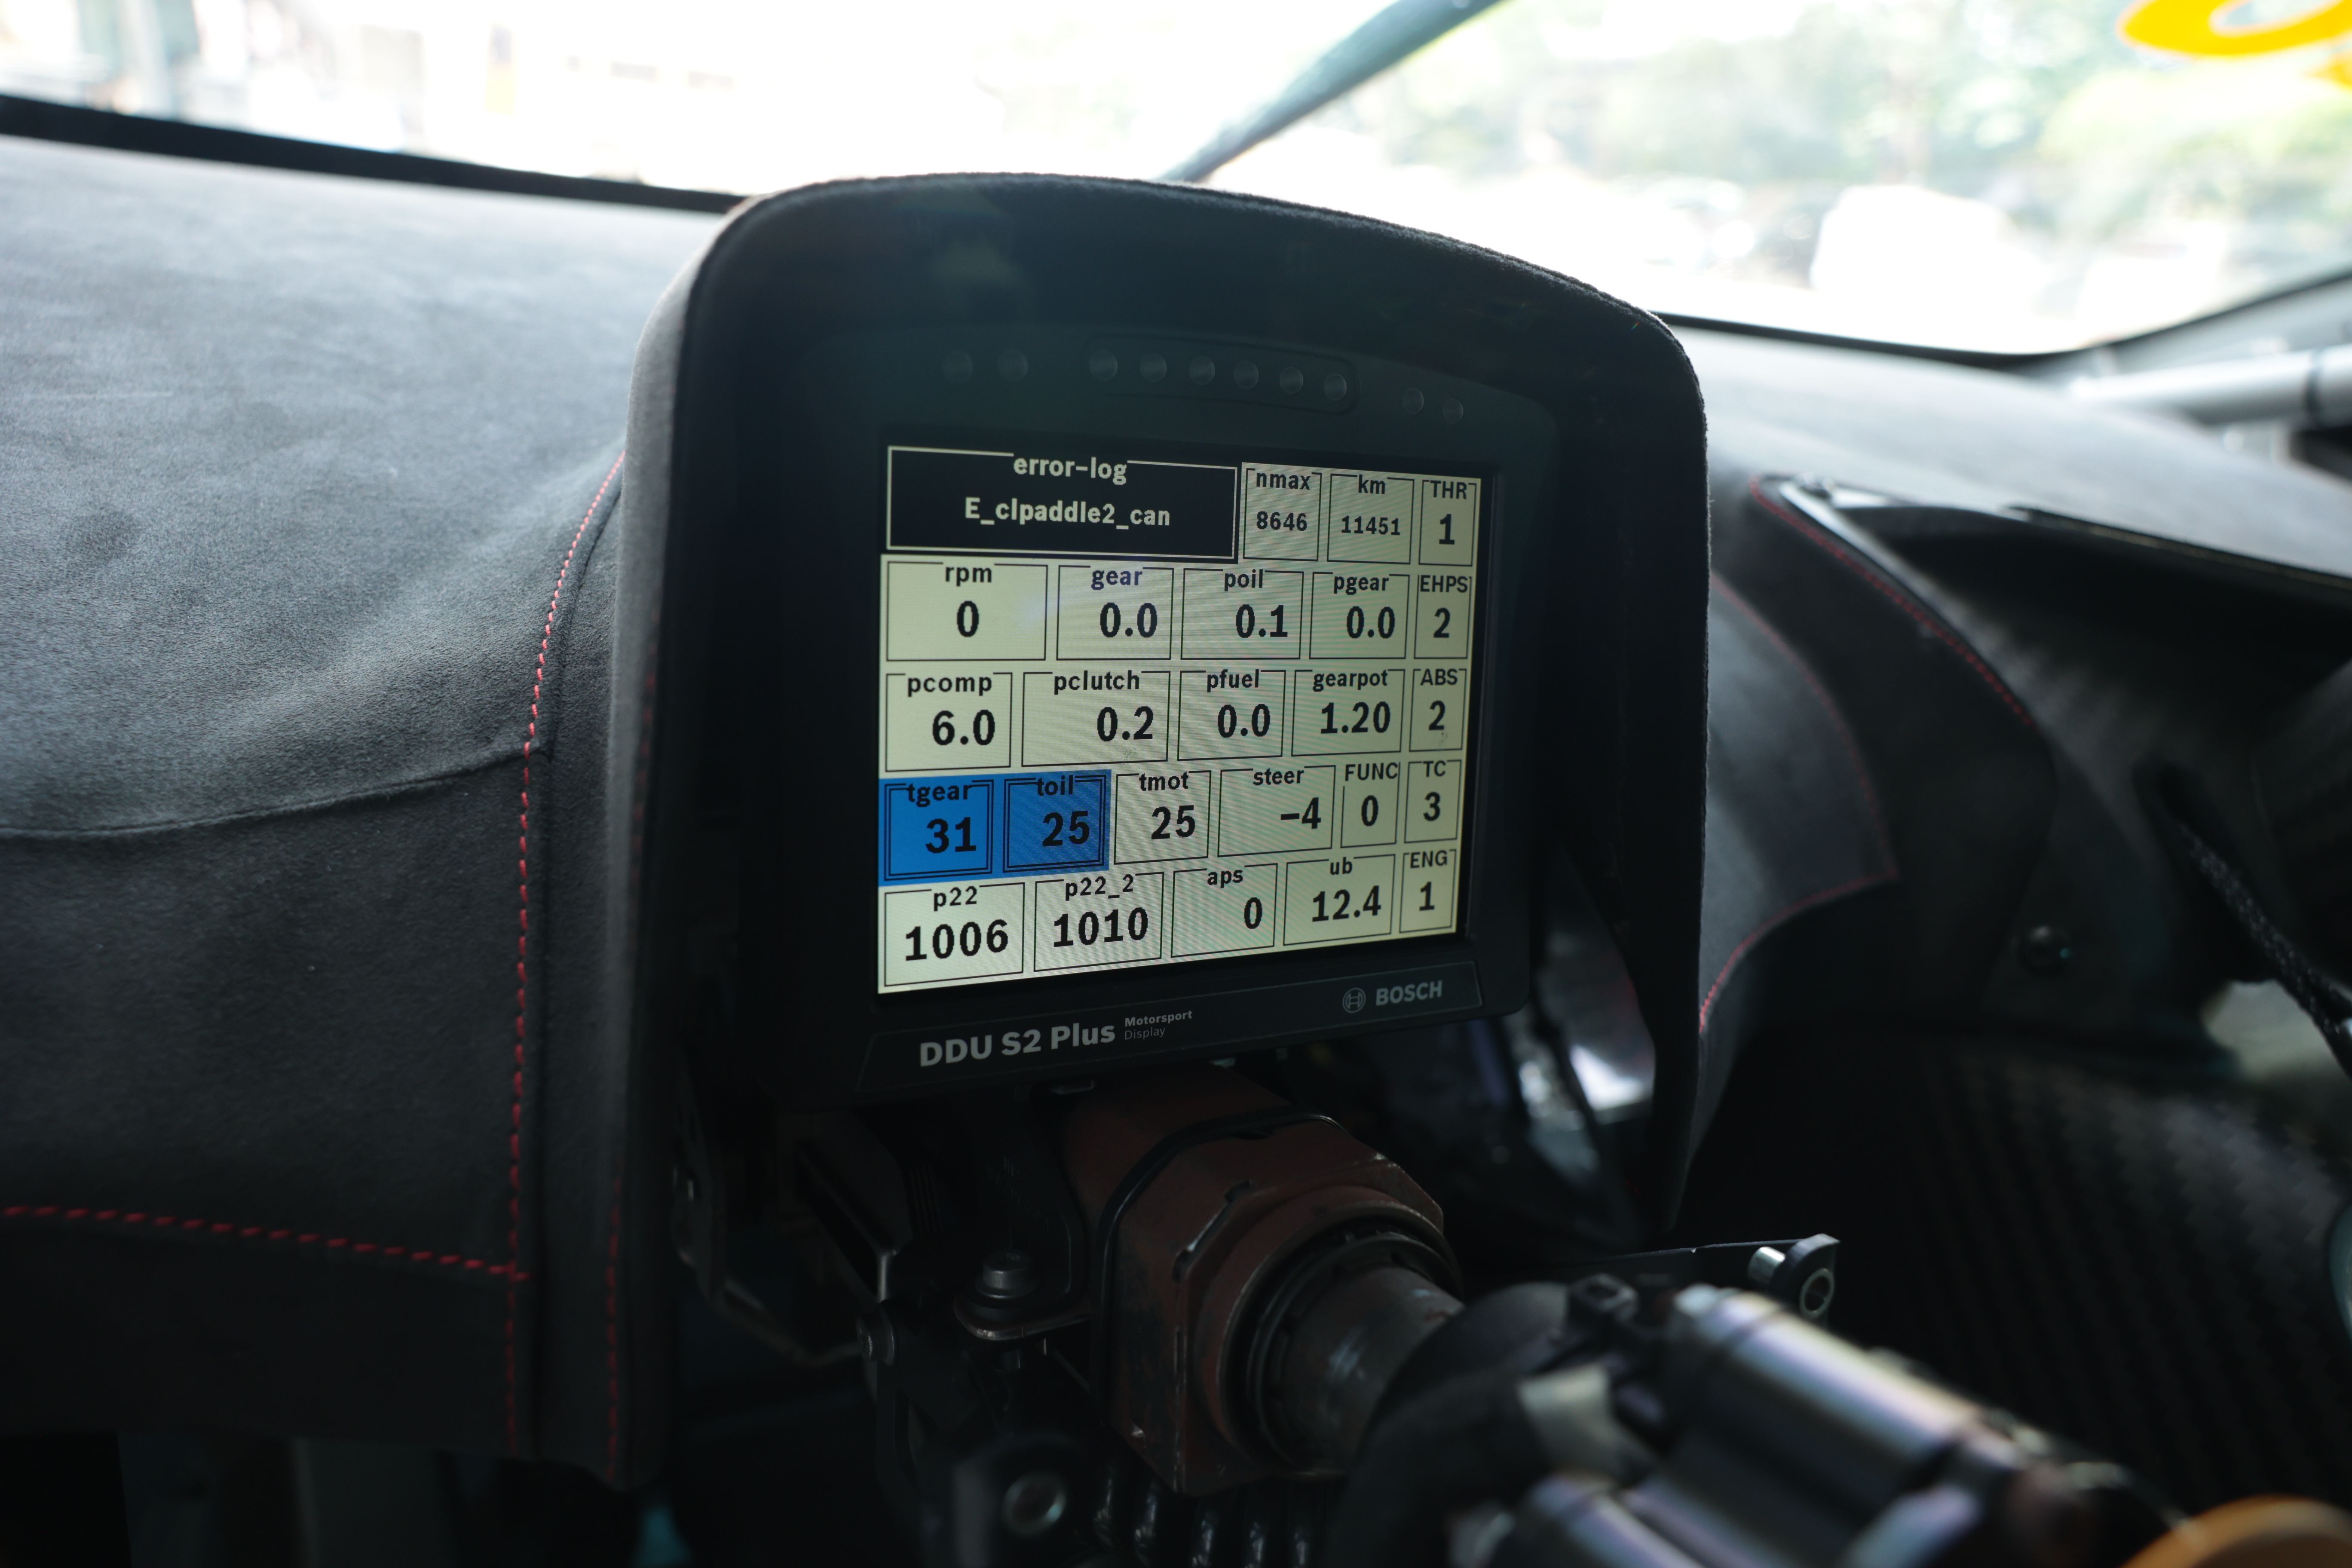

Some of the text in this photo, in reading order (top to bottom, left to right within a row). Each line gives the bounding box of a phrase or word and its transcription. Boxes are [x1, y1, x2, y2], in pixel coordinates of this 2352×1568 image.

[1014, 456, 1127, 485] error-log
[1256, 472, 1311, 490] nmax
[1358, 475, 1386, 495] km
[1430, 481, 1467, 499] THR
[965, 497, 1170, 530] E_clpaddle2_can
[1256, 511, 1308, 531] 8646
[1341, 516, 1400, 536] 11451
[1438, 514, 1455, 545] 1
[945, 566, 992, 587] rpm
[1091, 568, 1143, 591] gear
[1224, 569, 1264, 591] poil
[1333, 574, 1390, 595] pgear
[1420, 575, 1468, 593] EHPS
[956, 600, 980, 638] 0
[1099, 602, 1158, 638] 0.0
[1235, 604, 1288, 638] 0.1
[1346, 606, 1396, 639] 0.0
[1433, 607, 1451, 638] 2
[907, 675, 992, 697] pcomp
[1054, 671, 1140, 695] pclutch
[1207, 670, 1260, 692] pfuel
[1313, 670, 1388, 692] gearpot
[1420, 669, 1458, 686] ABS
[932, 710, 995, 745] 6.0
[1096, 707, 1154, 742] 0.2
[1217, 704, 1271, 738] 0.0
[1320, 701, 1391, 734] 1.20
[1428, 700, 1445, 731] 2
[1253, 768, 1305, 786] steer
[1344, 762, 1398, 781] FUNC
[1423, 760, 1446, 777] TC
[906, 782, 972, 807] tgear
[1036, 775, 1074, 796] toil
[1139, 772, 1189, 792] tmot
[1361, 795, 1379, 827] 0
[1423, 792, 1441, 821] 3
[925, 817, 977, 854] 31
[1042, 810, 1090, 847] 25
[1151, 805, 1196, 840] 25
[1330, 857, 1353, 875] ub
[1410, 851, 1448, 869] ENG
[1065, 873, 1134, 900] p22_2
[1207, 868, 1243, 888] aps
[933, 885, 978, 911] p22
[1311, 885, 1381, 922] 12.4
[1419, 882, 1435, 911] 1
[1243, 897, 1263, 929] 0
[905, 919, 1008, 961] 1006
[1053, 907, 1148, 948] 1010
[1375, 980, 1442, 1006] BOSCH
[1124, 1010, 1193, 1027] Motorsport
[920, 1023, 1115, 1067] DDU S2 Plus
[1124, 1026, 1165, 1041] Display
